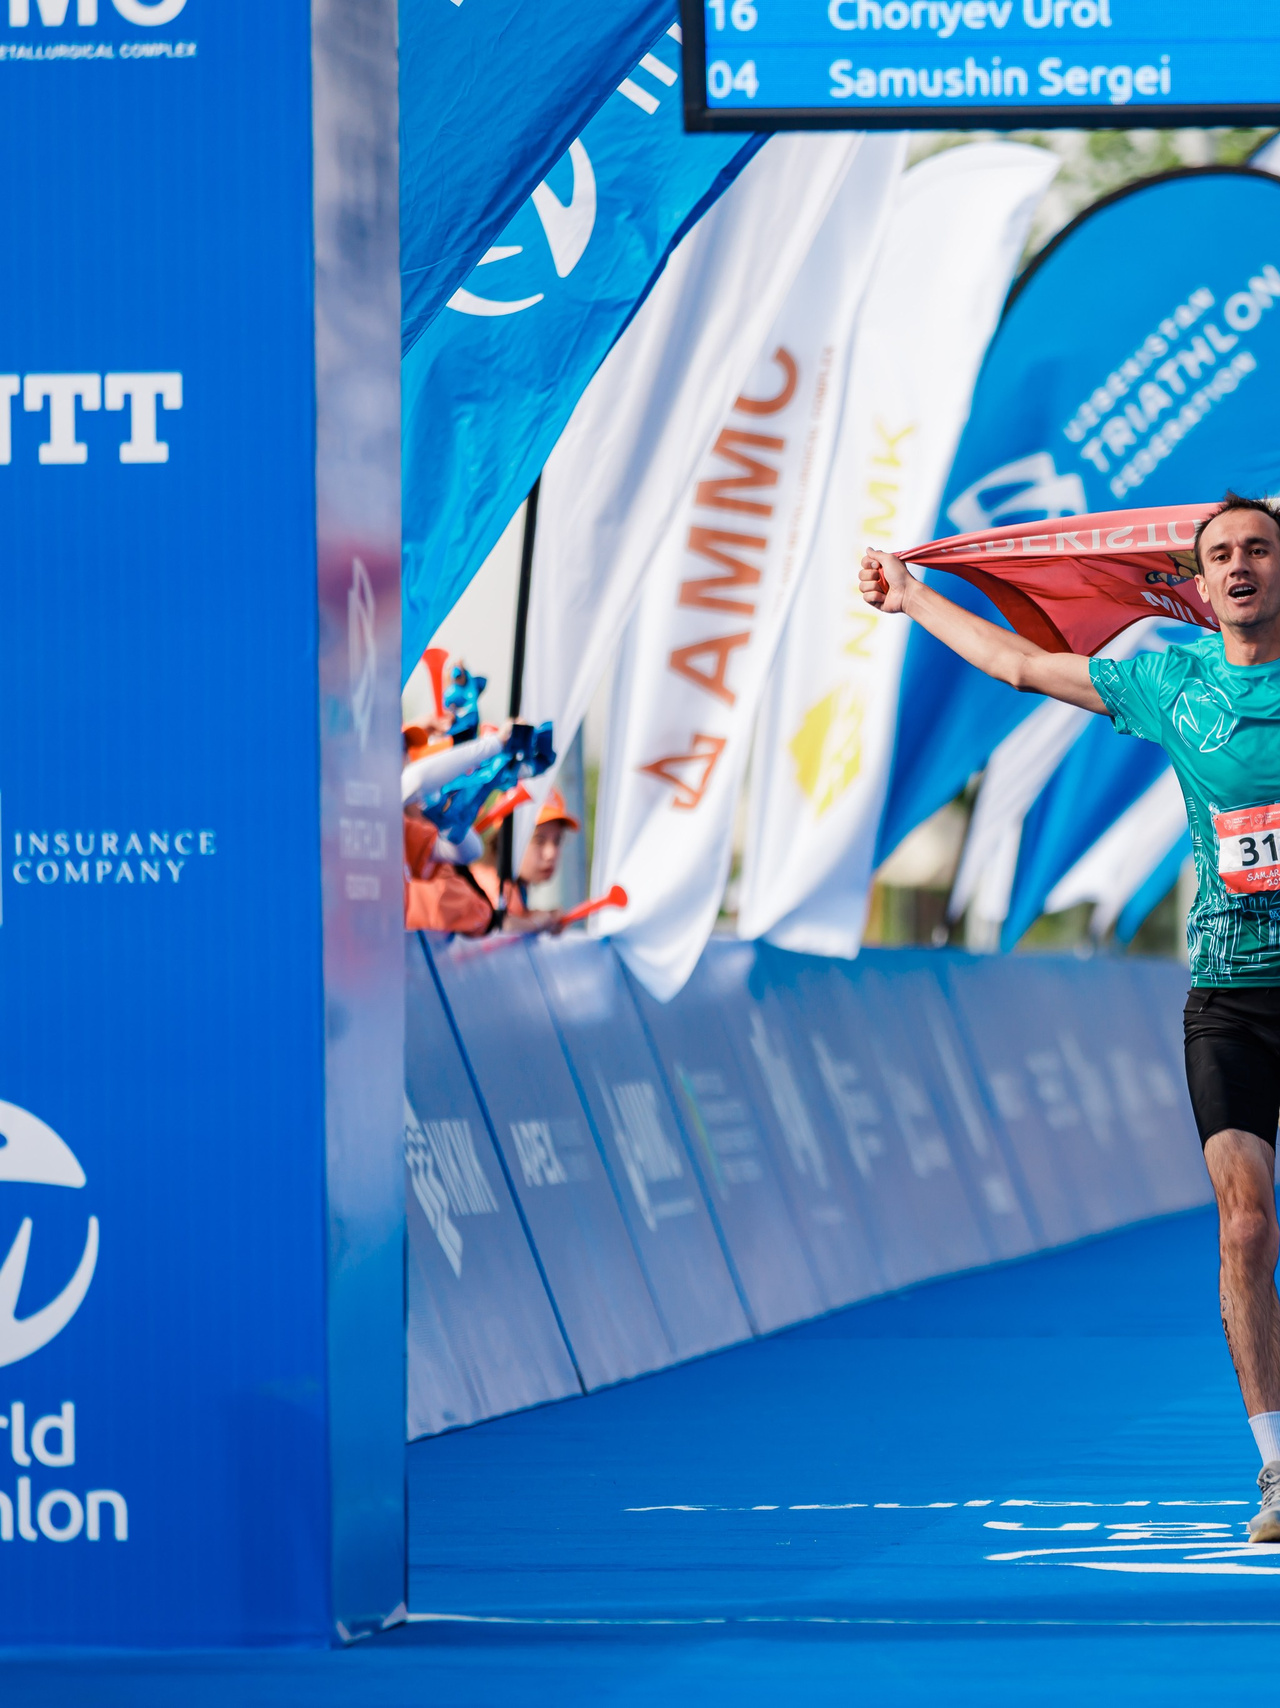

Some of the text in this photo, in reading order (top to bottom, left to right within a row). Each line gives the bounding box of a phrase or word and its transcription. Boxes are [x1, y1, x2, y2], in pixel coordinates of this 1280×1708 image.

[710, 0, 758, 31] 16
[829, 0, 1012, 38] Choriyev
[1023, 0, 1112, 29] Urol
[709, 60, 759, 98] 04
[829, 56, 1028, 98] Samushin
[1038, 54, 1171, 106] Sergei
[1063, 287, 1216, 442] UZBEKISTAN
[0, 372, 183, 465] TT
[1110, 350, 1257, 499] FEDERATION
[668, 346, 799, 709] AMMC
[842, 417, 919, 659] NMK
[13, 860, 184, 883] COMPANY
[15, 832, 215, 855] INSURANCE
[0, 1401, 75, 1467] ld
